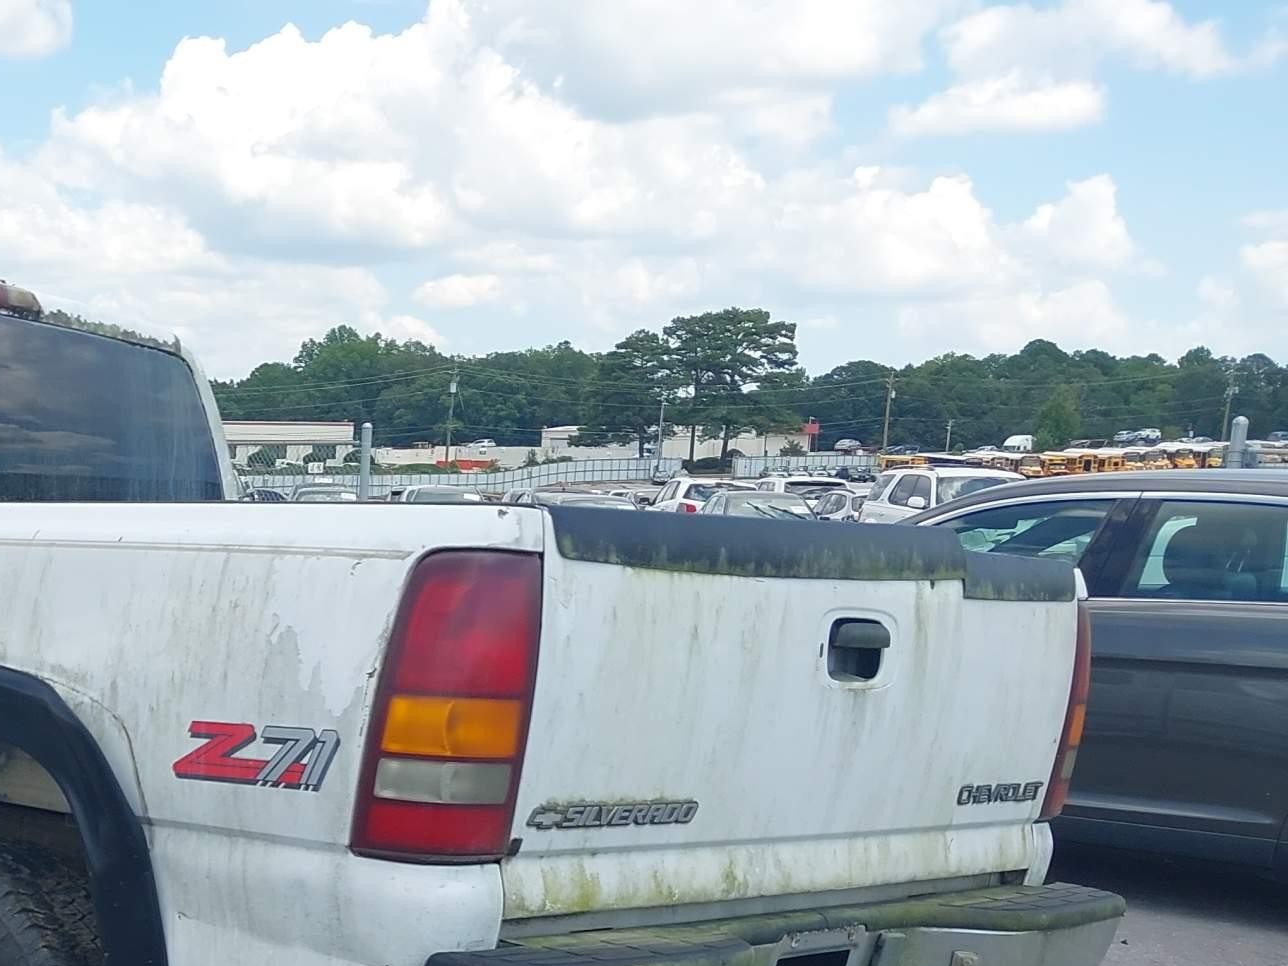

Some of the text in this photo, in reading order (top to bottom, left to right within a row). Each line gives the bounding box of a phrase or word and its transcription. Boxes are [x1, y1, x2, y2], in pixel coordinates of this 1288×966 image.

[172, 721, 341, 792] Z71
[956, 782, 1044, 806] CHEVROLET
[562, 801, 699, 828] SILVERADO
